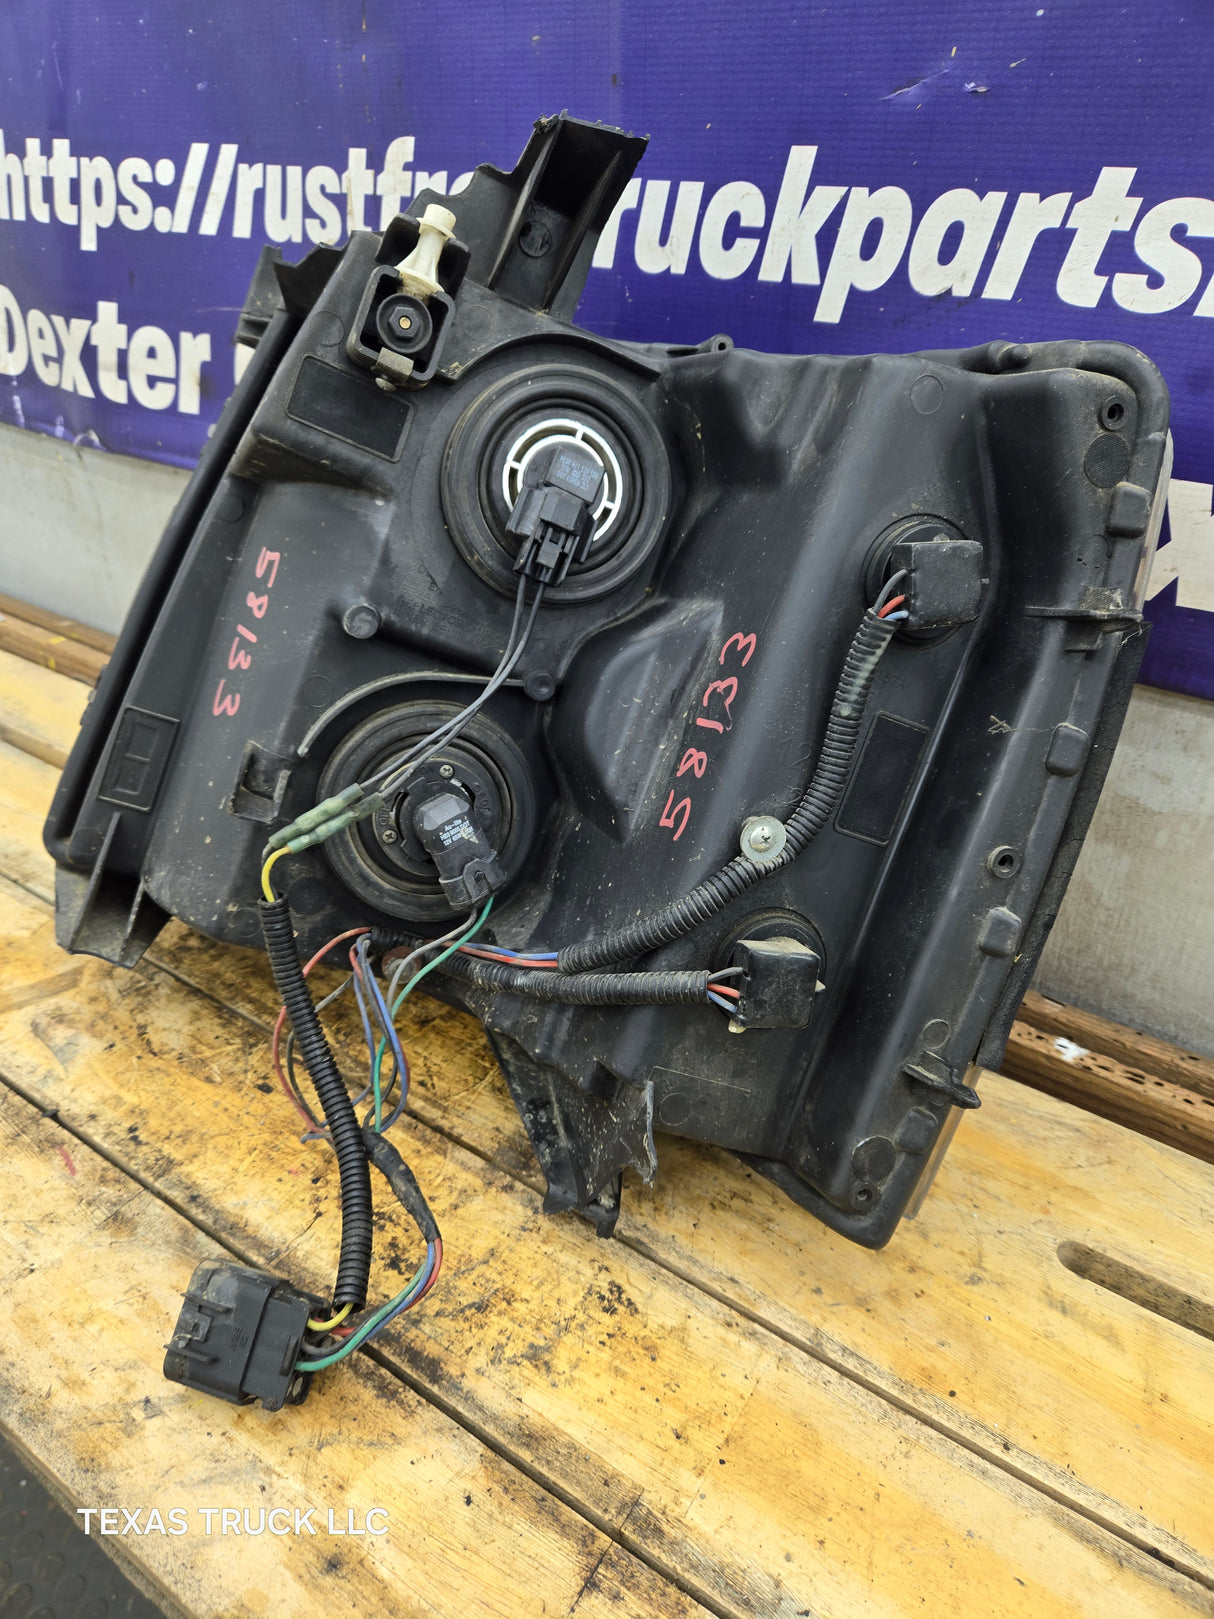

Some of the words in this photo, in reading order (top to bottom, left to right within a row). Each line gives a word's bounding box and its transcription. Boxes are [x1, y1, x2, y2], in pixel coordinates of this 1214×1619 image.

[0, 284, 211, 415] Dexter
[213, 546, 281, 716] 58133
[659, 632, 756, 841] 58133
